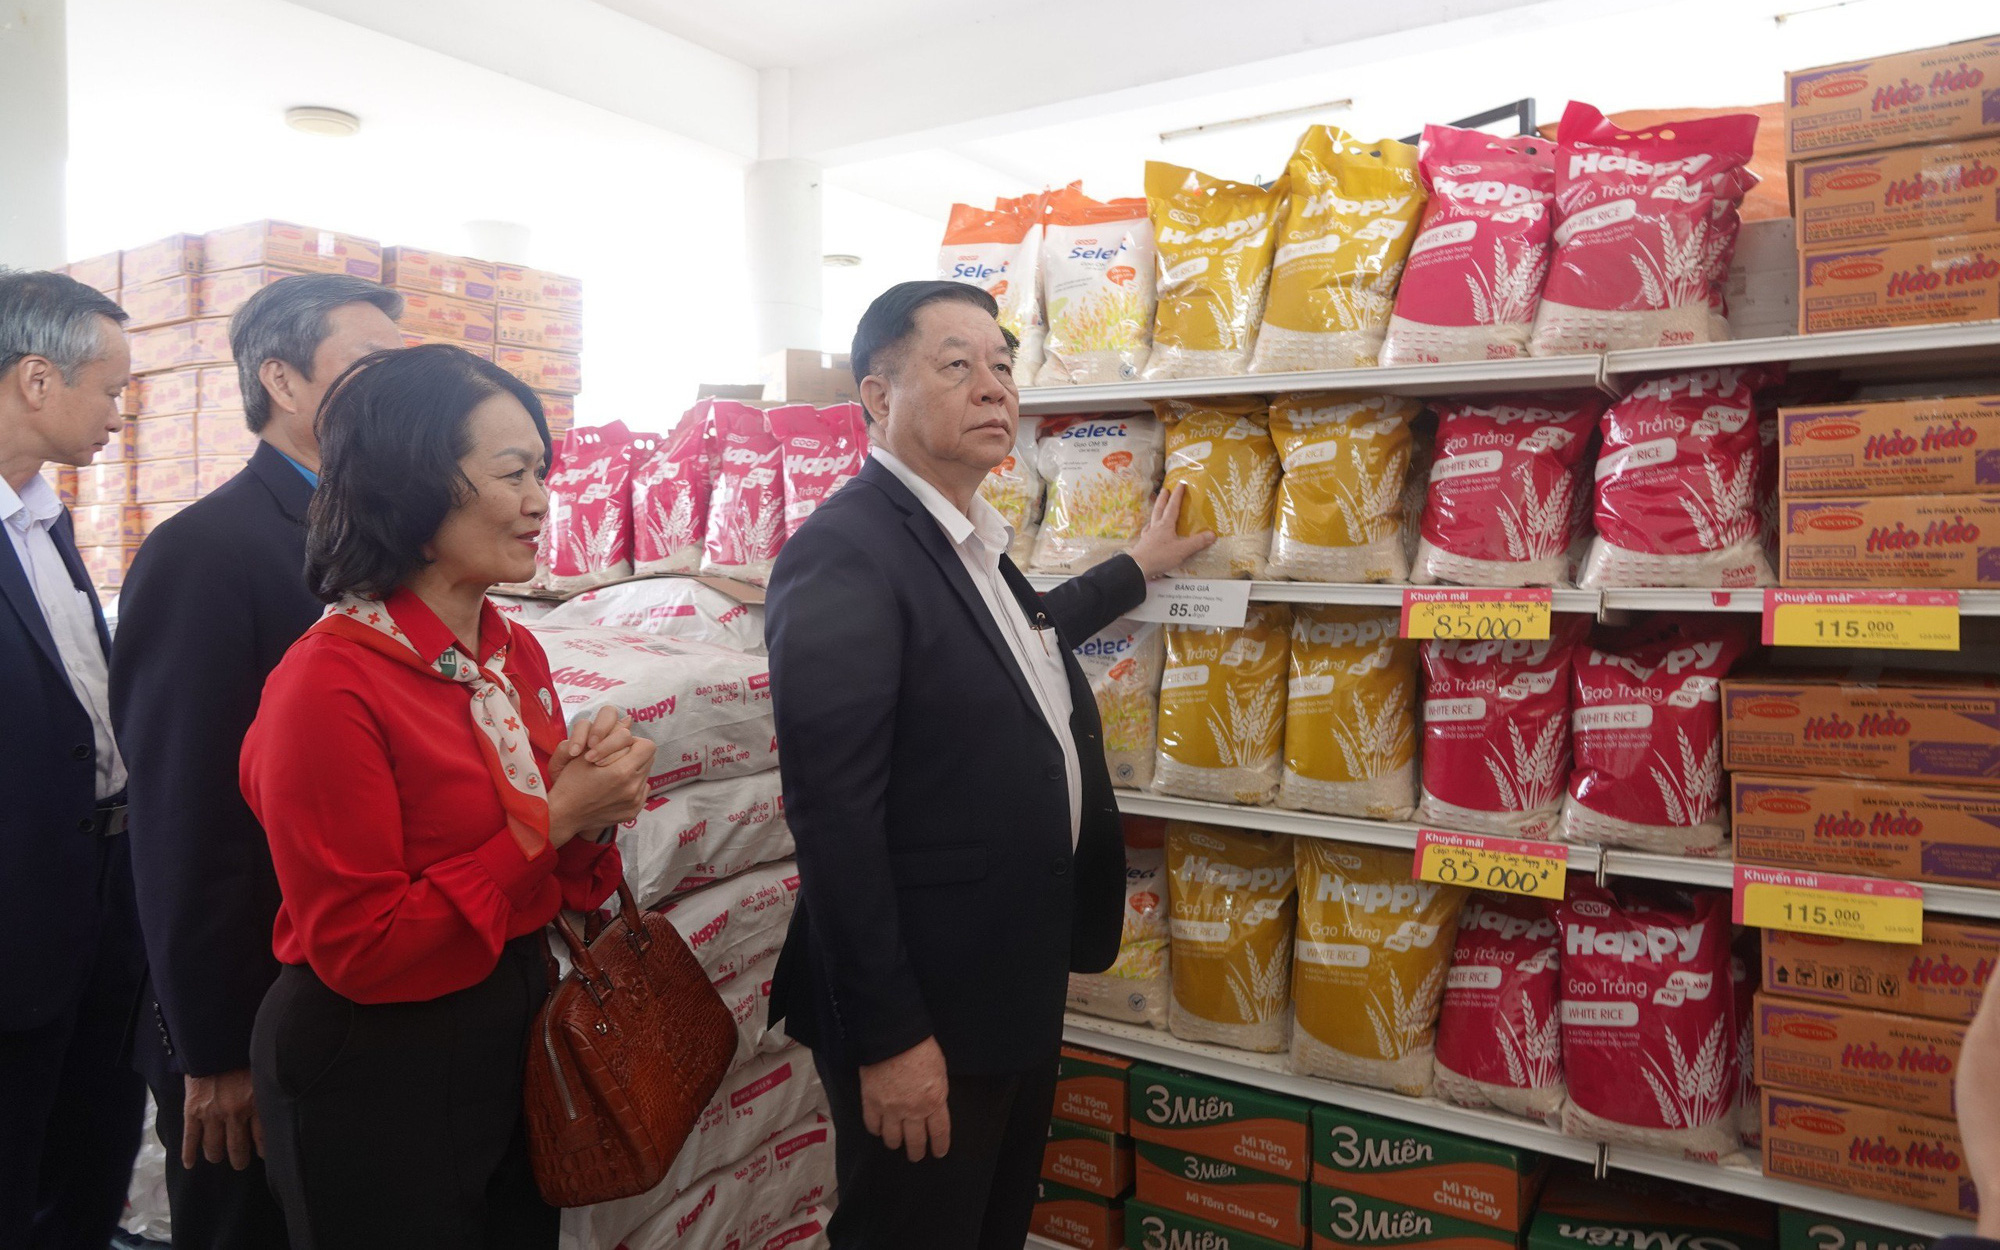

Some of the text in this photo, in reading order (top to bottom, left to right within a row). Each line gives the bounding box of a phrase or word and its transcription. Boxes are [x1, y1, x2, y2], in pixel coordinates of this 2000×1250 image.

[1569, 153, 1712, 179] Happy
[1301, 190, 1411, 218] Happy
[1600, 206, 1622, 221] RICE
[1158, 213, 1267, 244] Happy
[1661, 329, 1694, 342] Save
[1486, 343, 1517, 356] Save
[1061, 423, 1128, 439] Select
[1637, 413, 1687, 436] Trắng
[1472, 429, 1515, 447] Trắng
[1864, 419, 1977, 461] Hảo Hảo
[1637, 447, 1662, 460] RICE
[1440, 457, 1490, 475] WHITE RICE
[1866, 513, 1980, 554] Hảo Hảo
[1722, 564, 1756, 580] Save
[1410, 591, 1469, 603] Khuyến mãi
[1774, 590, 1850, 605] Khuyến mãi
[1183, 670, 1199, 682] RICE
[1454, 676, 1496, 693] Trắng
[1583, 685, 1613, 702] Gạo
[626, 694, 677, 724] Happy
[1428, 703, 1473, 716] WHITE RICE
[1580, 710, 1638, 724] WHITE RICE
[1803, 712, 1855, 742] Hảo
[1858, 709, 1912, 738] Hảo
[1520, 821, 1548, 836] Save
[1814, 810, 1866, 839] Hảo
[1869, 808, 1924, 837] Hảo
[1425, 832, 1484, 848] Khuyến mãi
[1180, 854, 1295, 893] Happy
[1743, 869, 1818, 888] Khuyến mãi
[1316, 873, 1441, 914] Happy
[1574, 902, 1609, 916] COOP
[689, 909, 729, 950] Happy
[1199, 925, 1219, 937] RICE
[1566, 923, 1705, 963] Happy
[1306, 948, 1357, 961] WHITE RICE
[1468, 971, 1489, 983] RICE
[1568, 975, 1648, 998] Gạo Trắng
[1568, 1008, 1624, 1021] WHITE RICE
[1842, 1041, 1895, 1070] Hảo
[1898, 1044, 1953, 1074] Hảo
[1067, 1093, 1109, 1111] Mì Tôm
[1061, 1101, 1114, 1124] Chua Cay
[1241, 1135, 1287, 1155] Mì Tôm
[1848, 1135, 1901, 1166] Hảo
[1905, 1140, 1960, 1172] Hảo
[1058, 1153, 1098, 1174] Mì Tôm
[1233, 1145, 1293, 1171] Chua Cay
[1052, 1163, 1103, 1188] Chua Cay
[1442, 1180, 1495, 1204] Mì Tôm
[1186, 1191, 1279, 1228] Mì Tôm Chua Cay
[1433, 1191, 1502, 1221] Chua Cay
[1064, 1218, 1089, 1234] Tôm
[1075, 1231, 1095, 1249] Cay
